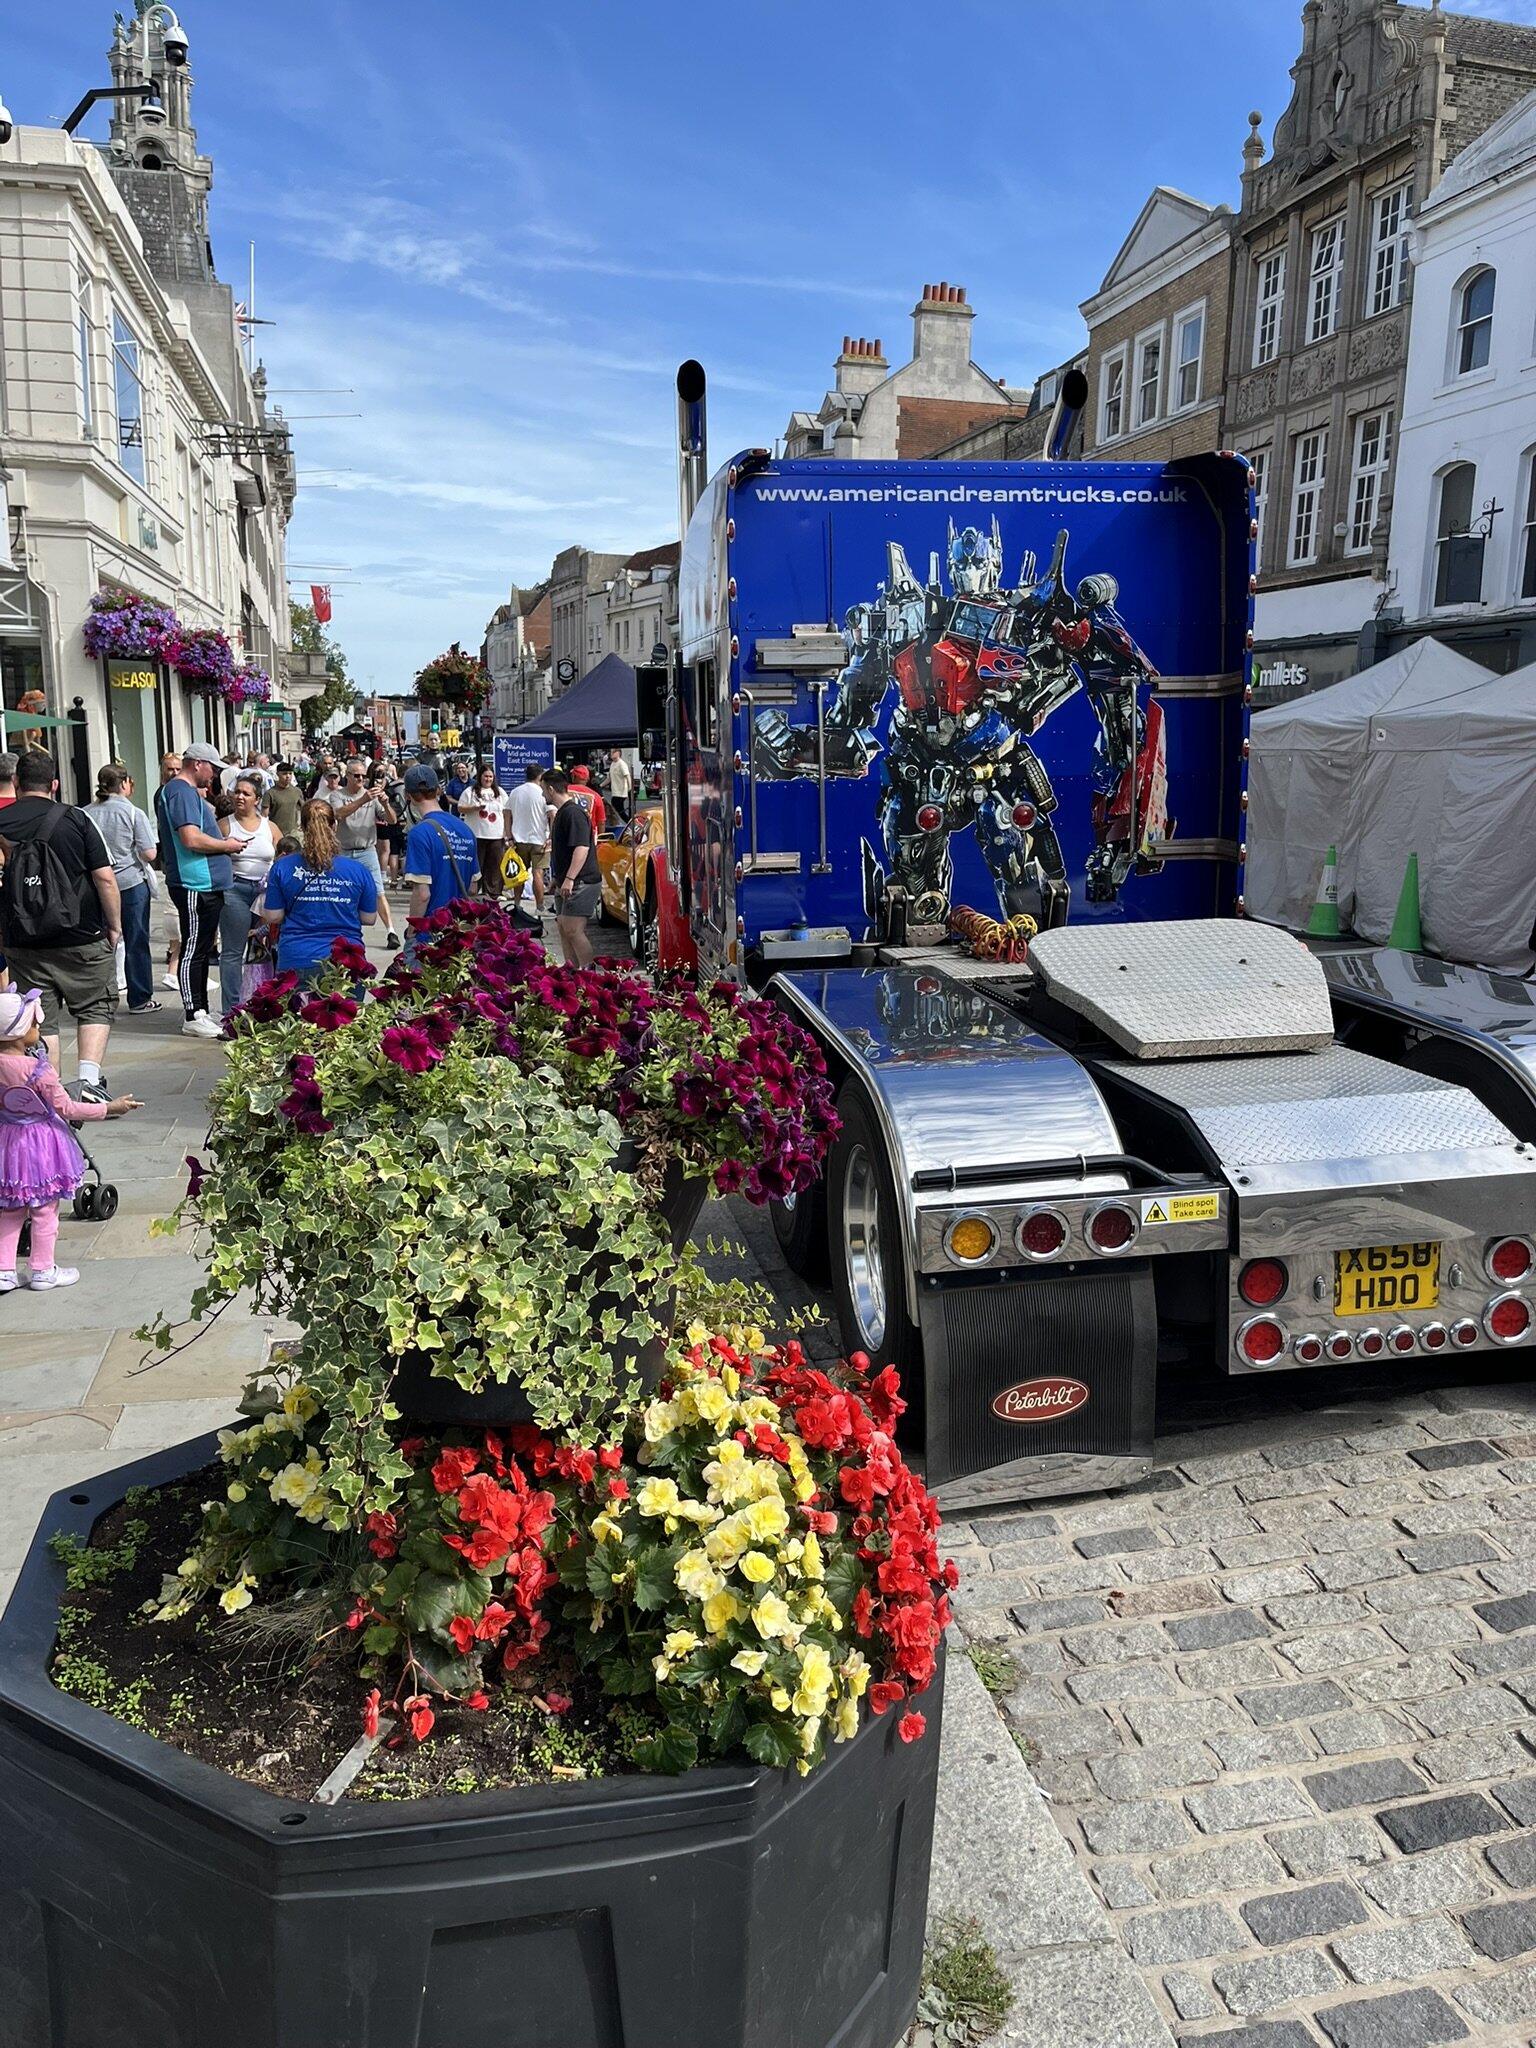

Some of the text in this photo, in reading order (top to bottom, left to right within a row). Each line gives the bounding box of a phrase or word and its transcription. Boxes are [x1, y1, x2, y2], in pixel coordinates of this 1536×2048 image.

[755, 484, 1188, 504] www.americandreamtrucks.co.uk
[1260, 661, 1307, 687] millets
[1173, 1199, 1214, 1209] Blind spot
[1174, 1208, 1214, 1218] Take care
[1345, 1242, 1432, 1273] X658
[1355, 1274, 1419, 1309] HDO
[1005, 1386, 1080, 1414] Peterbilt
